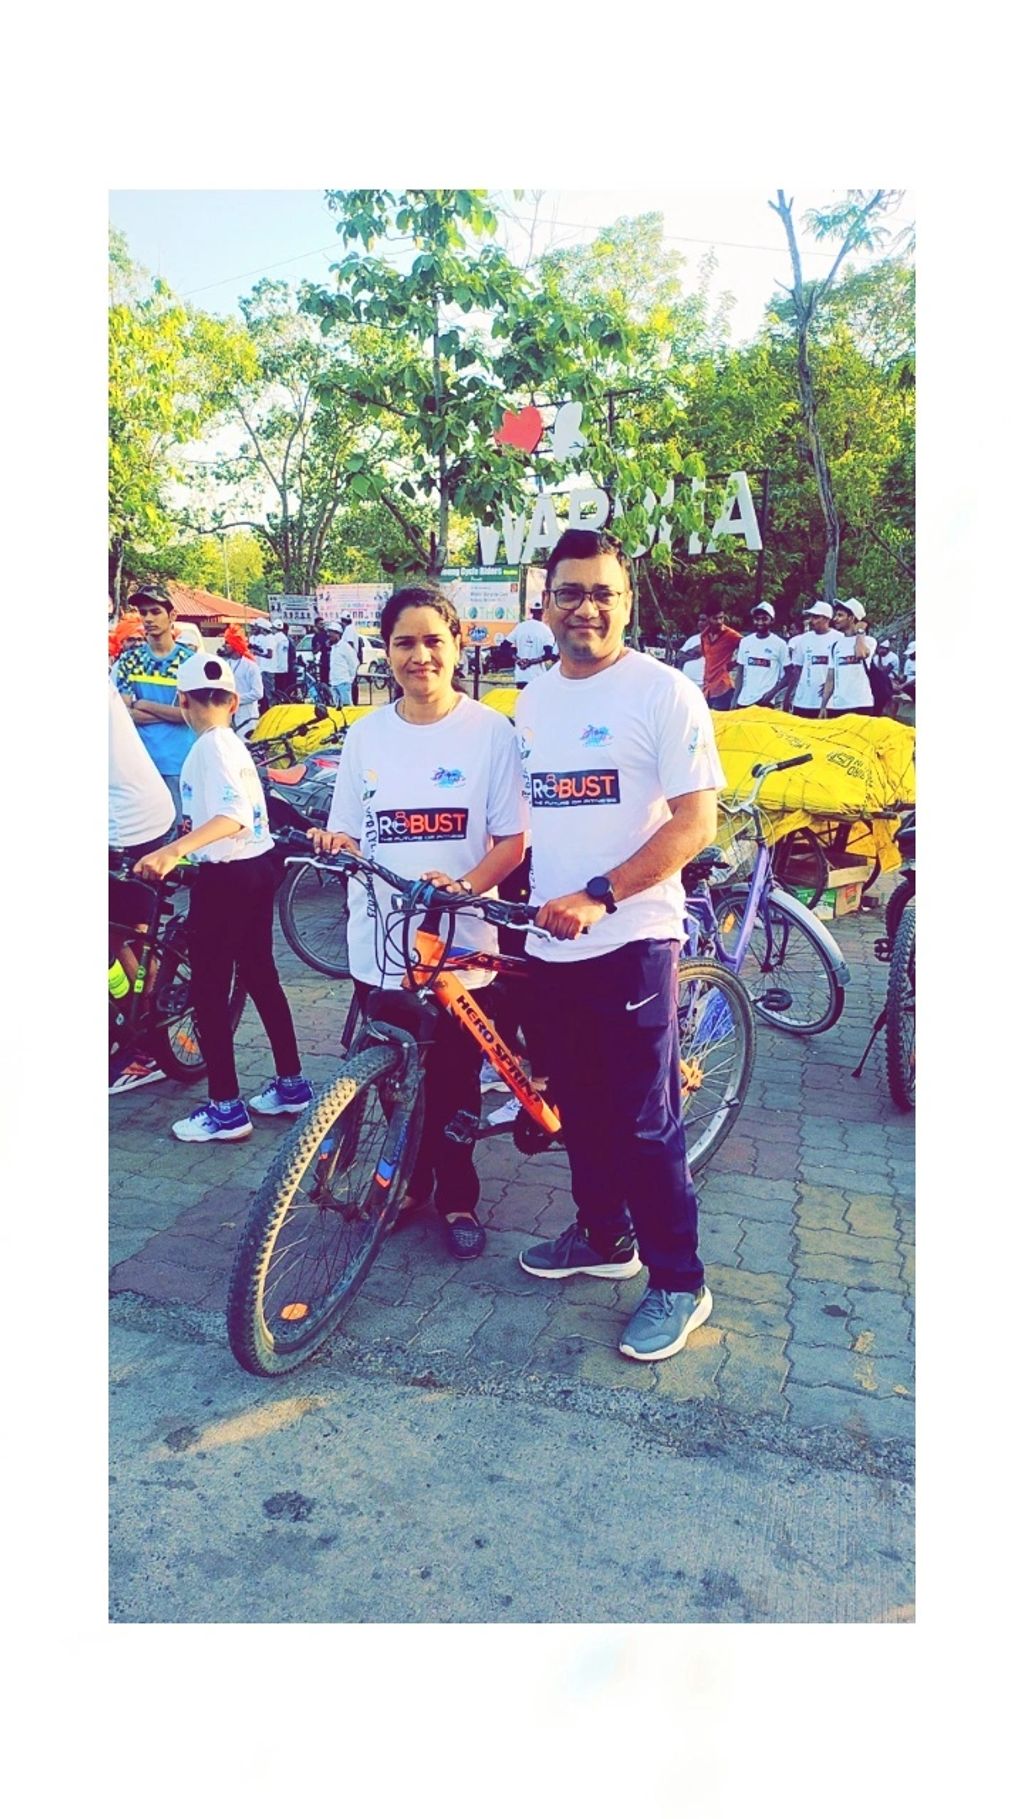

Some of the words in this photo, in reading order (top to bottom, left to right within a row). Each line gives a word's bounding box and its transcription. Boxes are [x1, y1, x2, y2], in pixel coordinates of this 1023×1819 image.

[533, 774, 615, 799] ROBUST
[379, 811, 466, 835] ROBUST
[456, 995, 494, 1043] HERO
